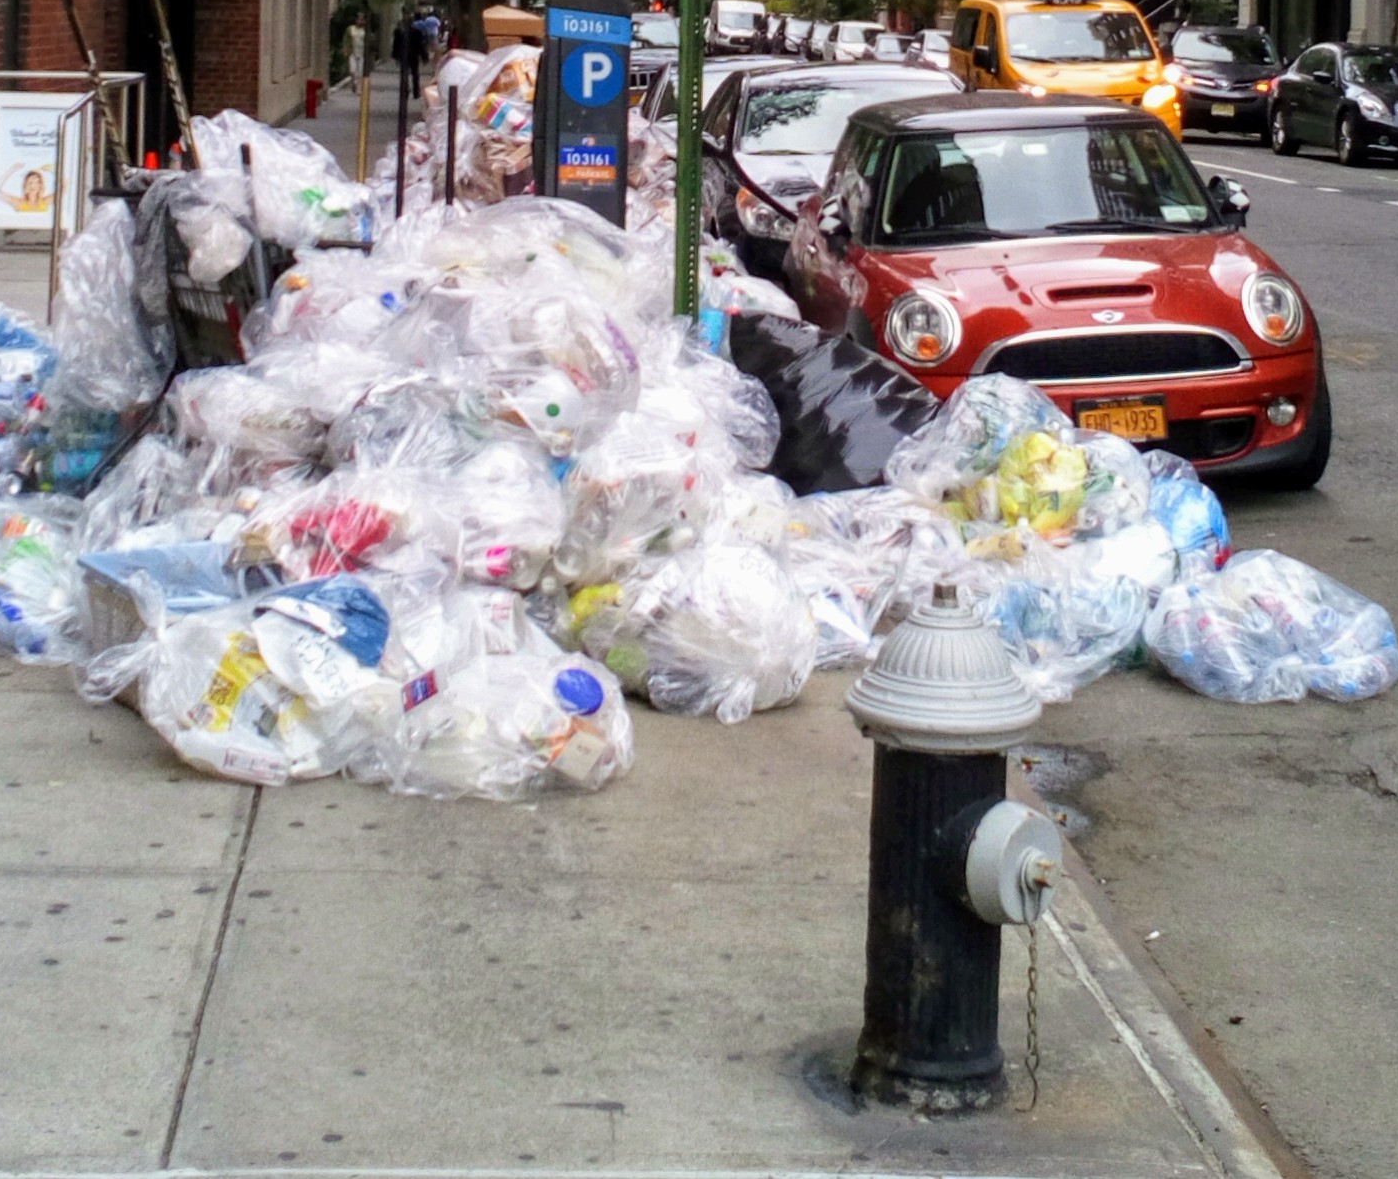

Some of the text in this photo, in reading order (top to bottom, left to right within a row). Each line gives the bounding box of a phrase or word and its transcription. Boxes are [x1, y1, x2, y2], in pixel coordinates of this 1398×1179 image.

[564, 18, 610, 34] 103161
[582, 51, 613, 99] P
[566, 152, 610, 166] 103161
